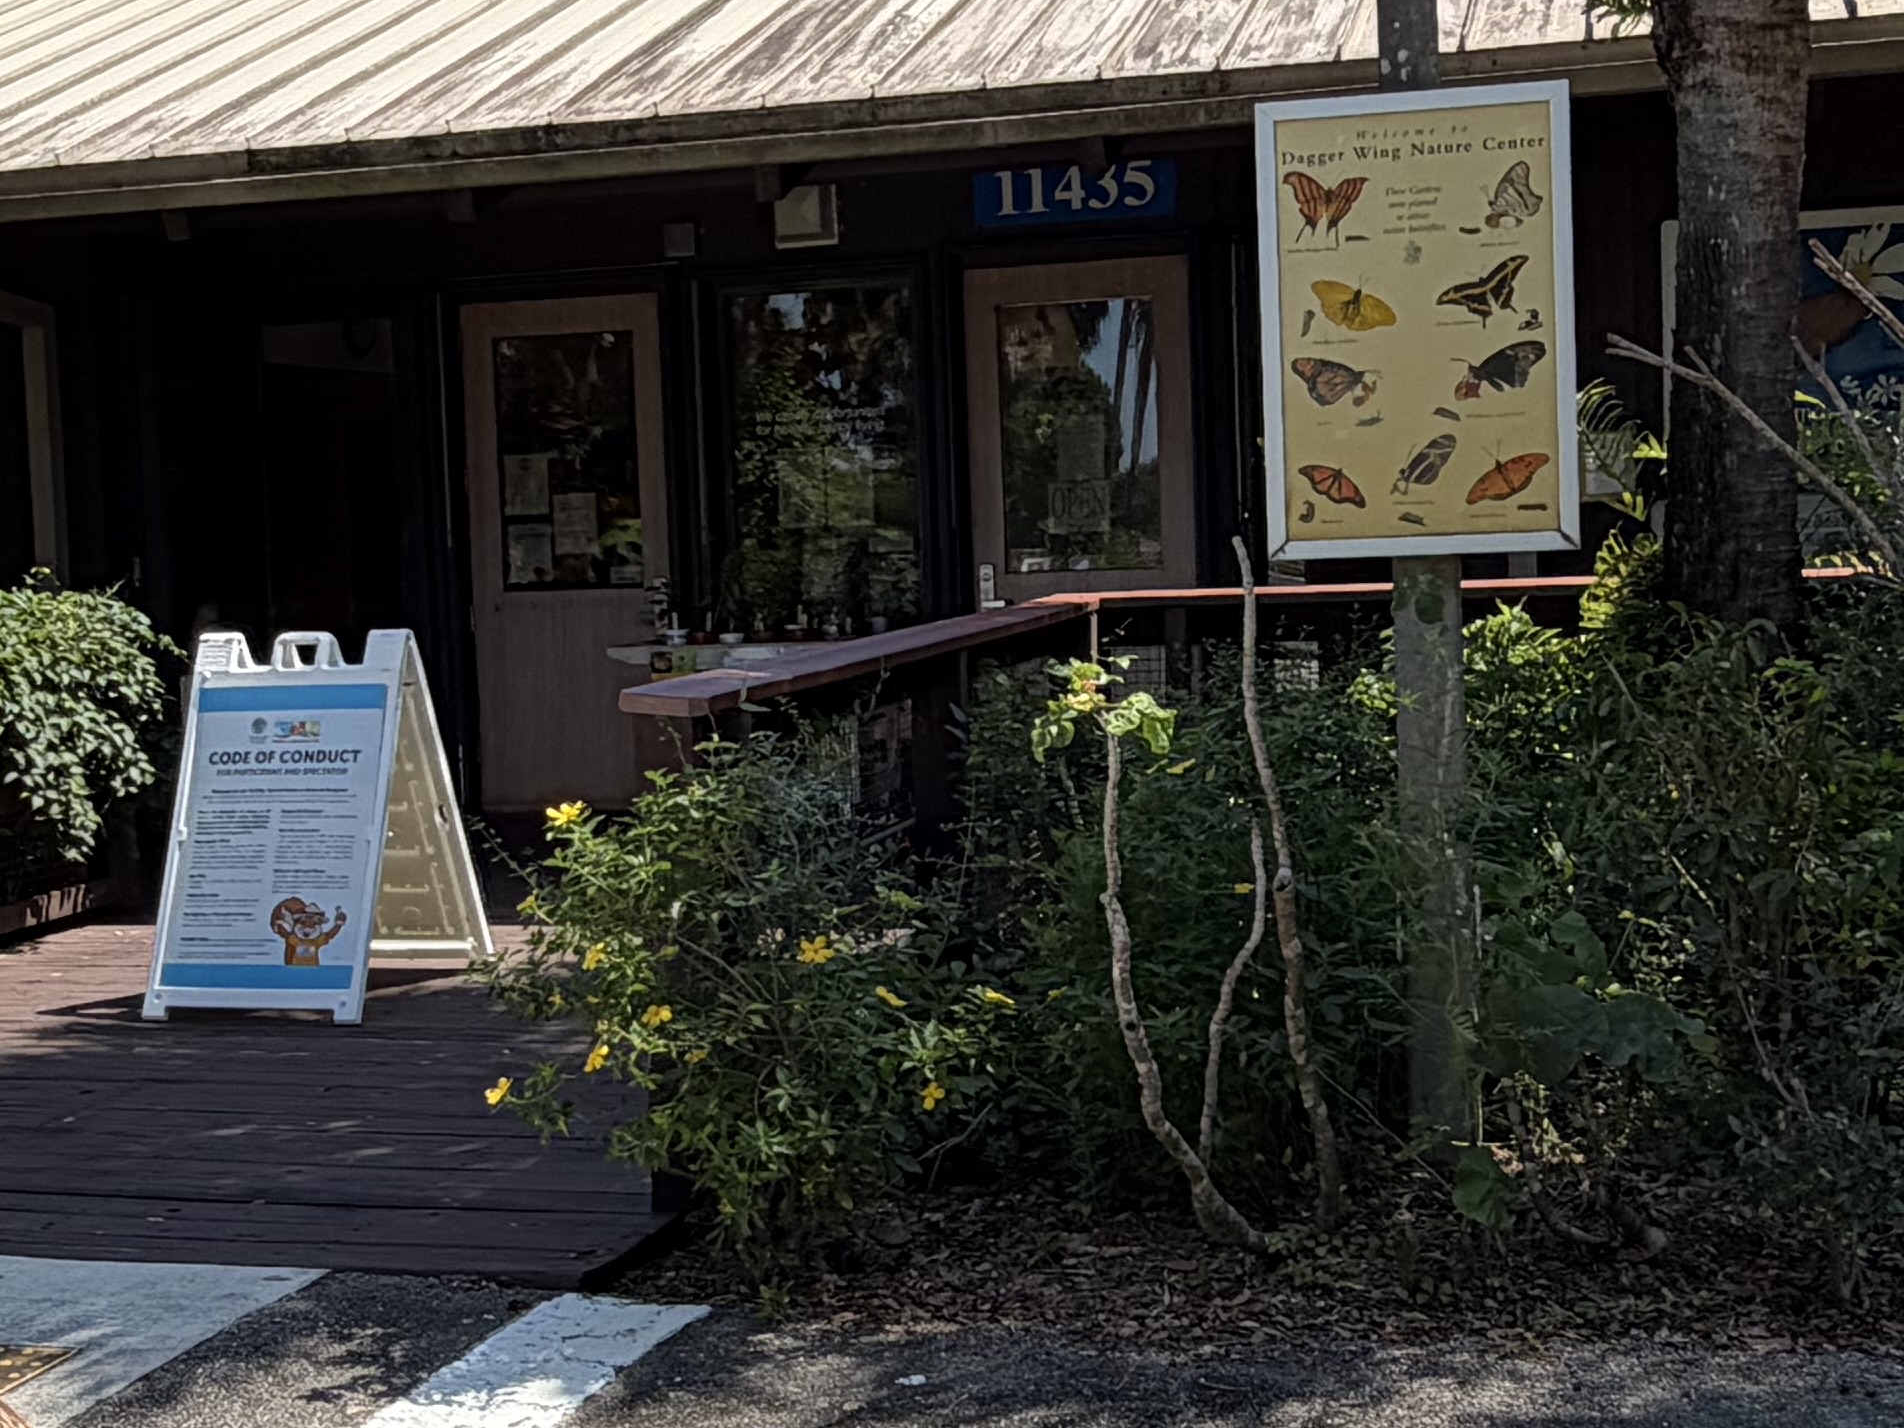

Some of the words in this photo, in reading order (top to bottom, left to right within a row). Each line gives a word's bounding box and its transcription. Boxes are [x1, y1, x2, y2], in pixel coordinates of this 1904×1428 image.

[1356, 127, 1435, 141] Welcome
[1451, 124, 1468, 134] to
[1281, 151, 1344, 168] Dagger
[1352, 145, 1401, 162] Wing
[1410, 140, 1473, 156] Nature
[1482, 136, 1545, 151] Center
[993, 160, 1156, 217] 11435
[208, 751, 252, 766] CODE
[254, 750, 277, 764] OF
[279, 749, 363, 764] CONDUCT
